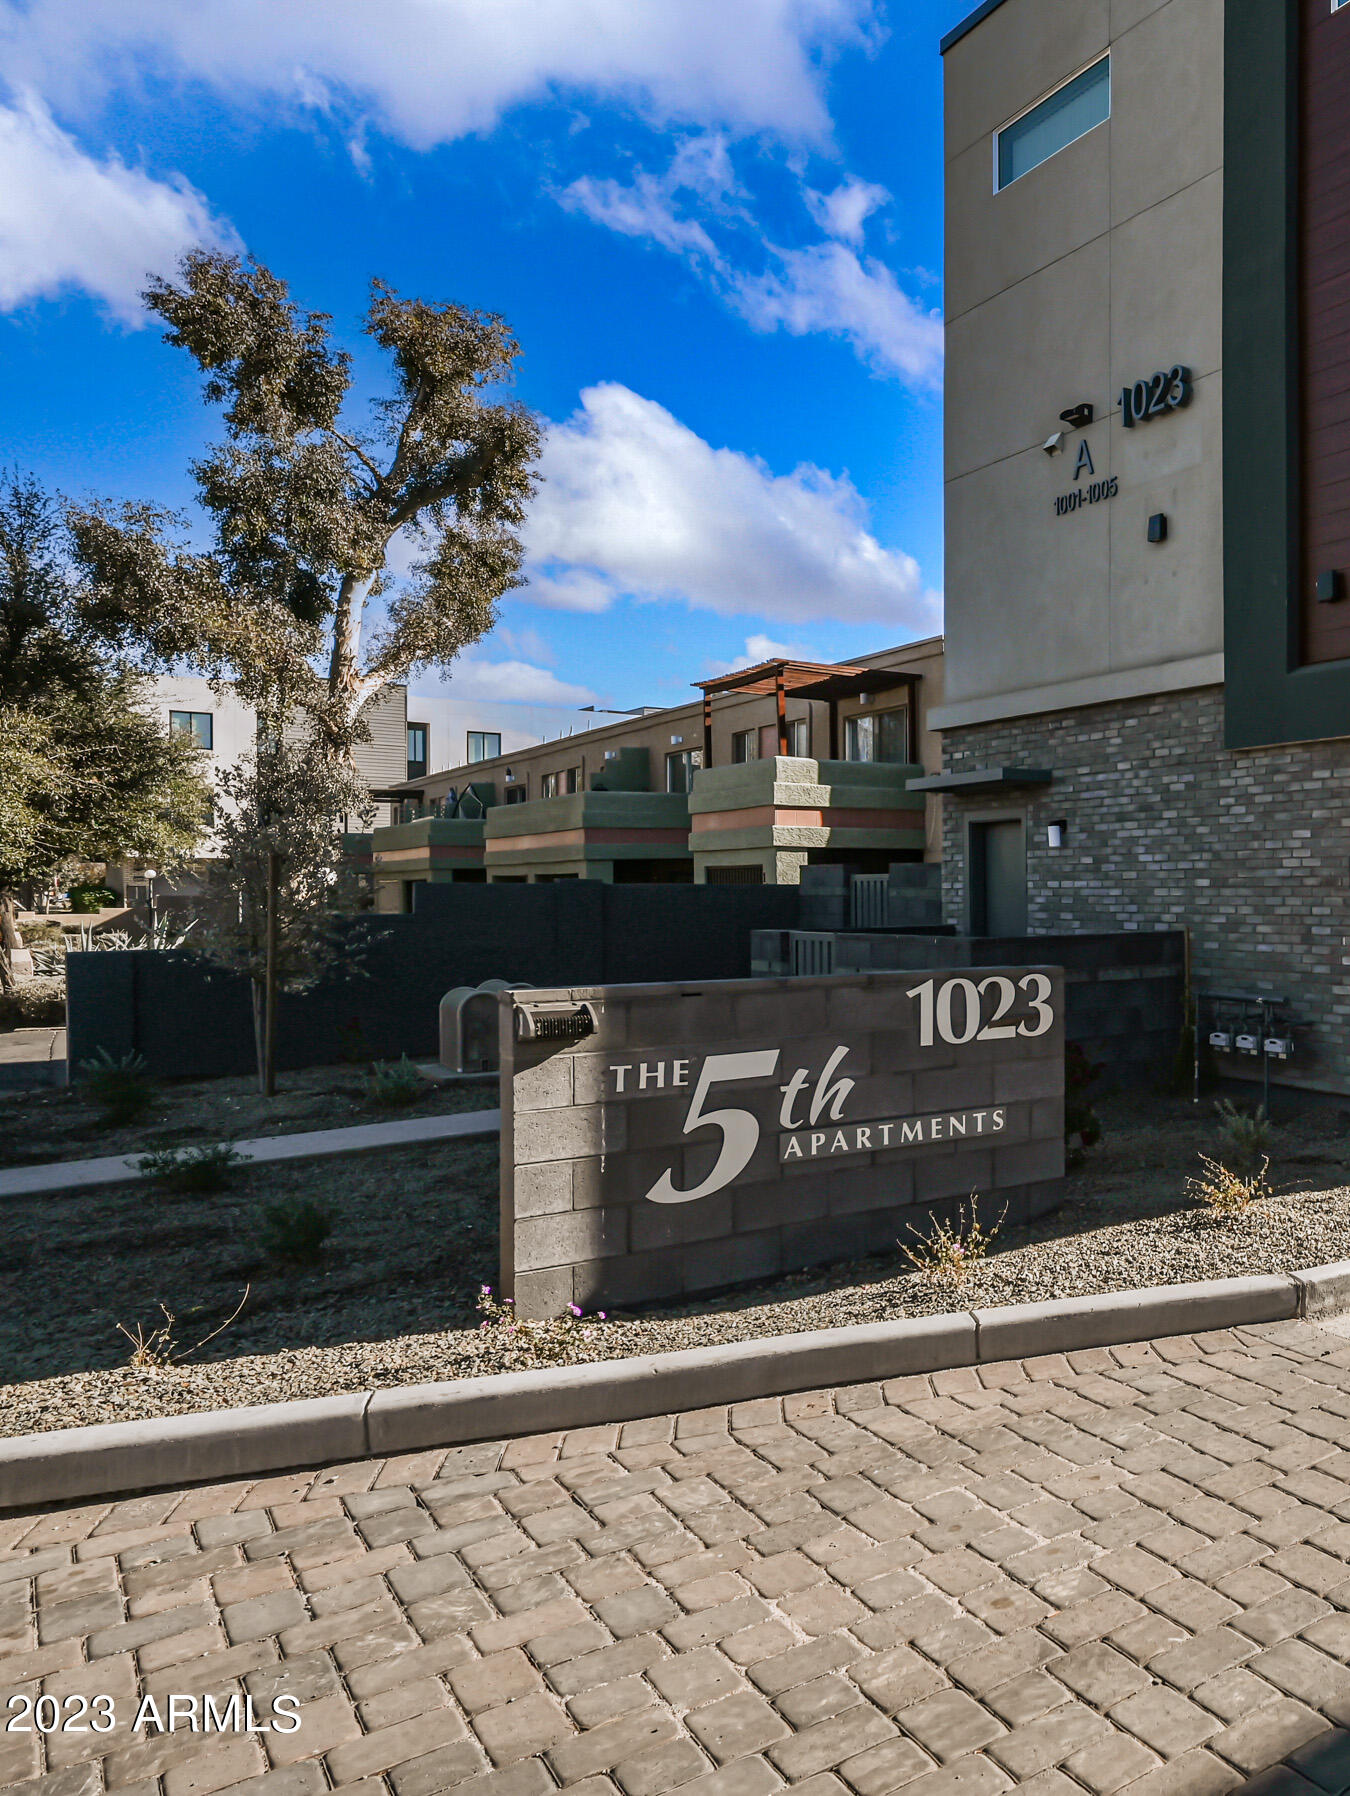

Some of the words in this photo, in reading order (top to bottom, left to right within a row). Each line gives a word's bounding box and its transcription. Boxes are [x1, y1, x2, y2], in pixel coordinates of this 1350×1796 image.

[1117, 364, 1192, 428] 1023
[1073, 439, 1095, 481] A
[1054, 476, 1119, 516] 1001-1005
[905, 973, 1055, 1047] 1023
[609, 1059, 690, 1093] THE
[783, 1109, 1006, 1160] APARTMENTS
